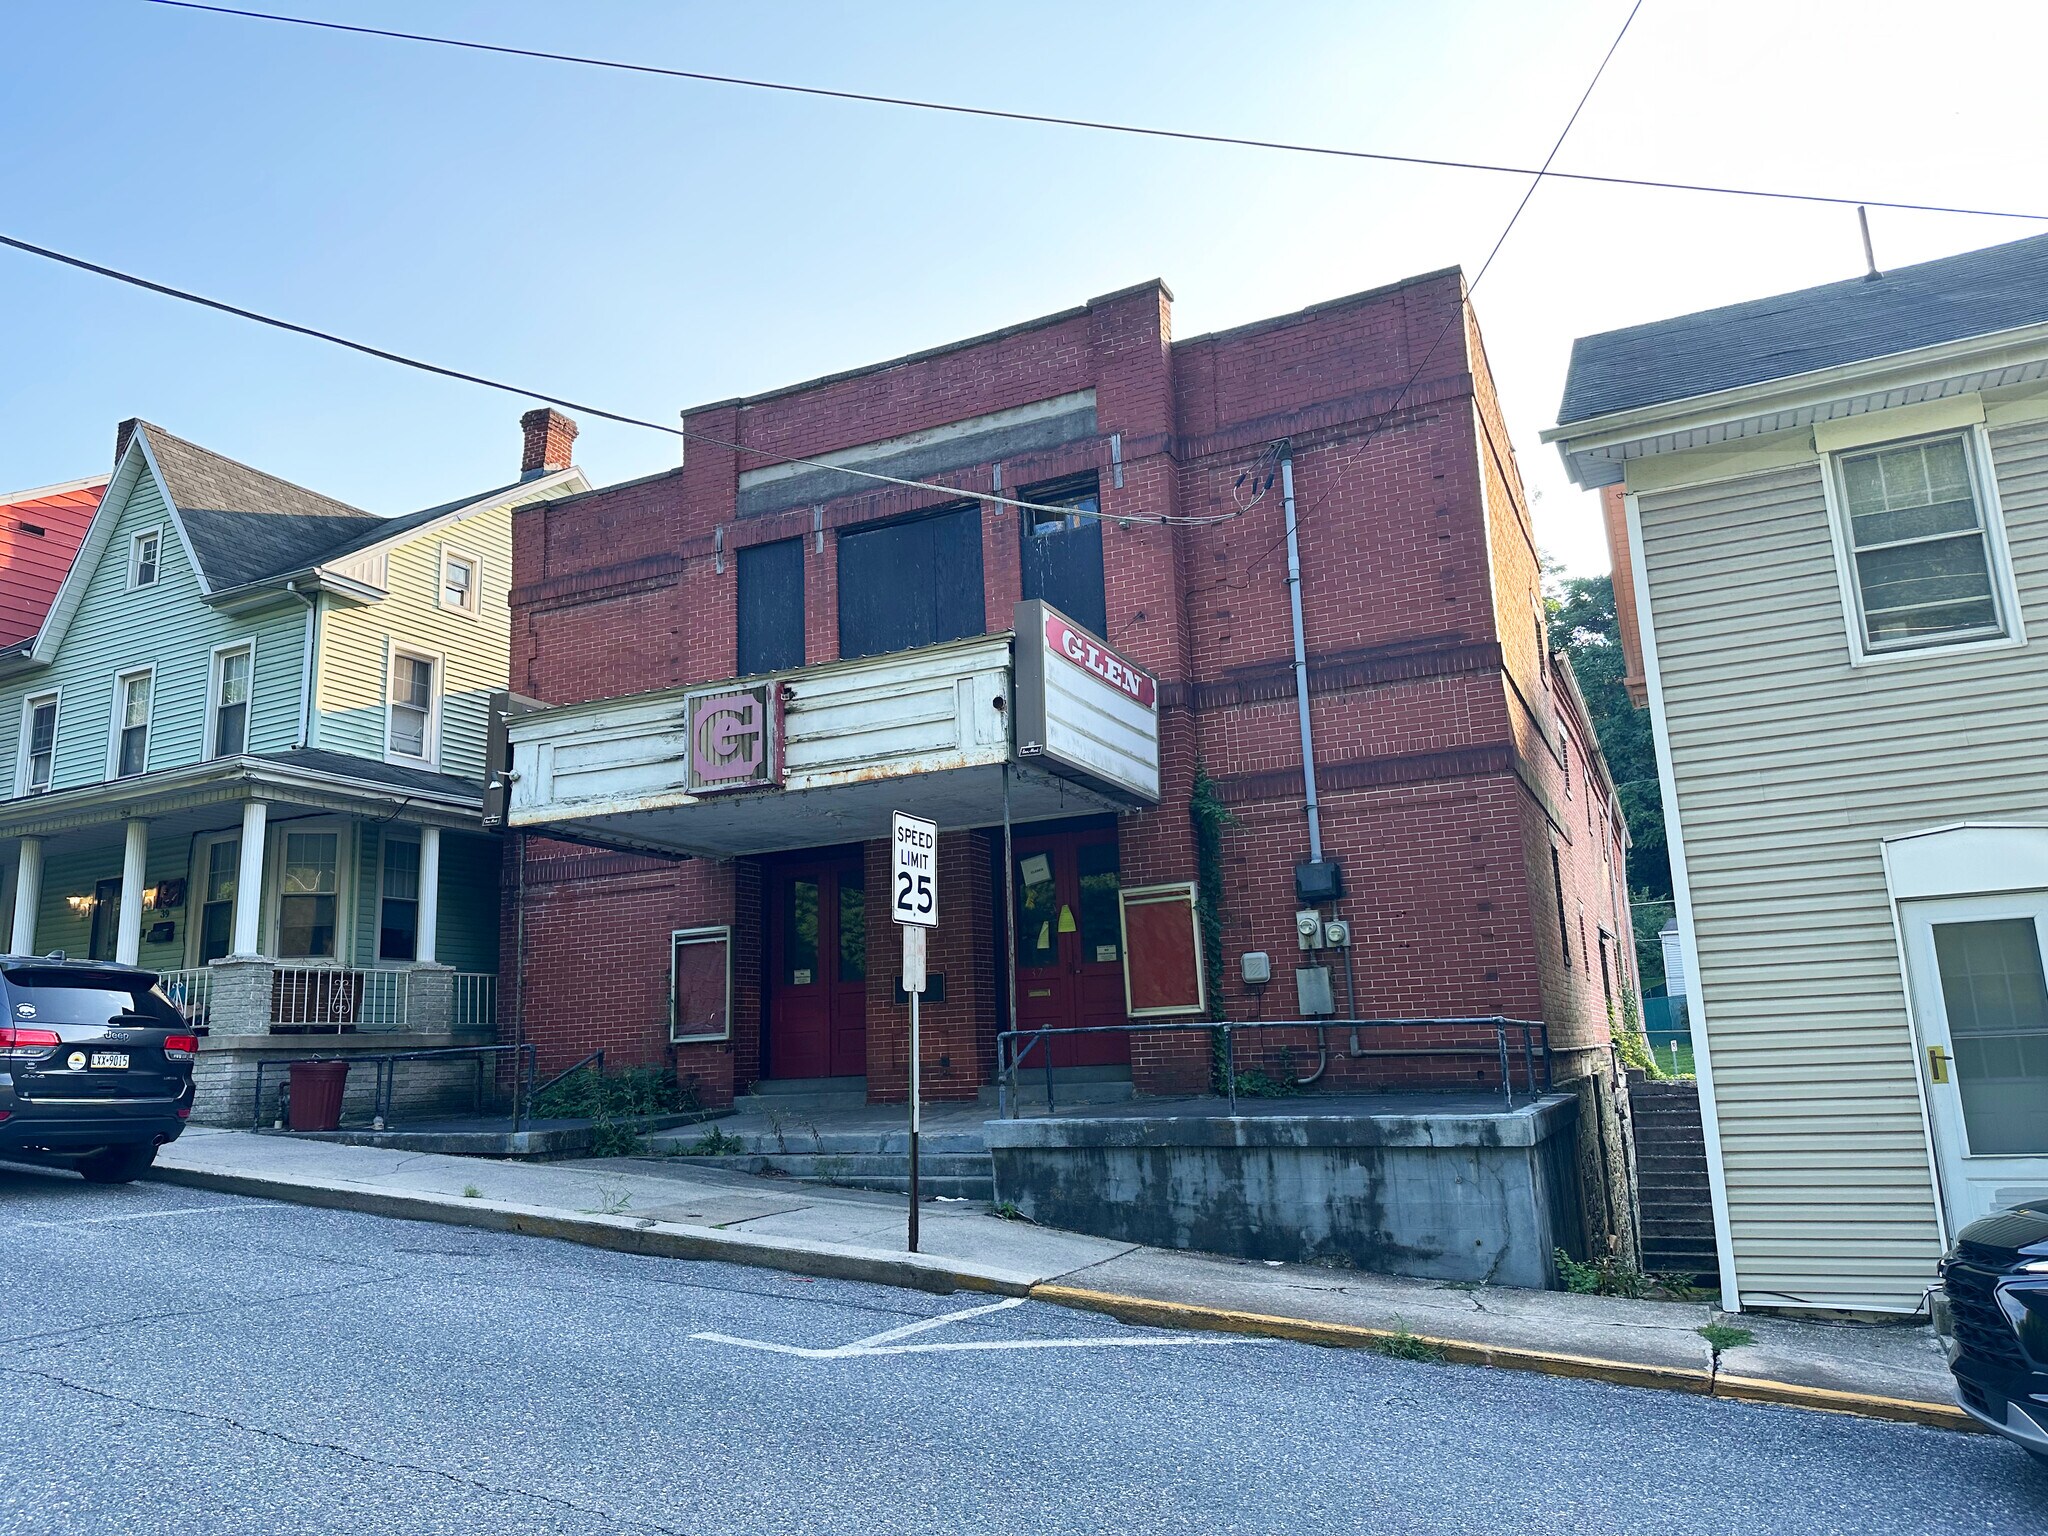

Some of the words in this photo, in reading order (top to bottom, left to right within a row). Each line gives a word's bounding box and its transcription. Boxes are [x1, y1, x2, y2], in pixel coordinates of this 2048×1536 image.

[1062, 629, 1142, 696] GLEN
[897, 826, 933, 849] SPEED
[901, 849, 929, 870] LIMIT
[897, 871, 932, 914] 25
[104, 1030, 129, 1042] Jeep
